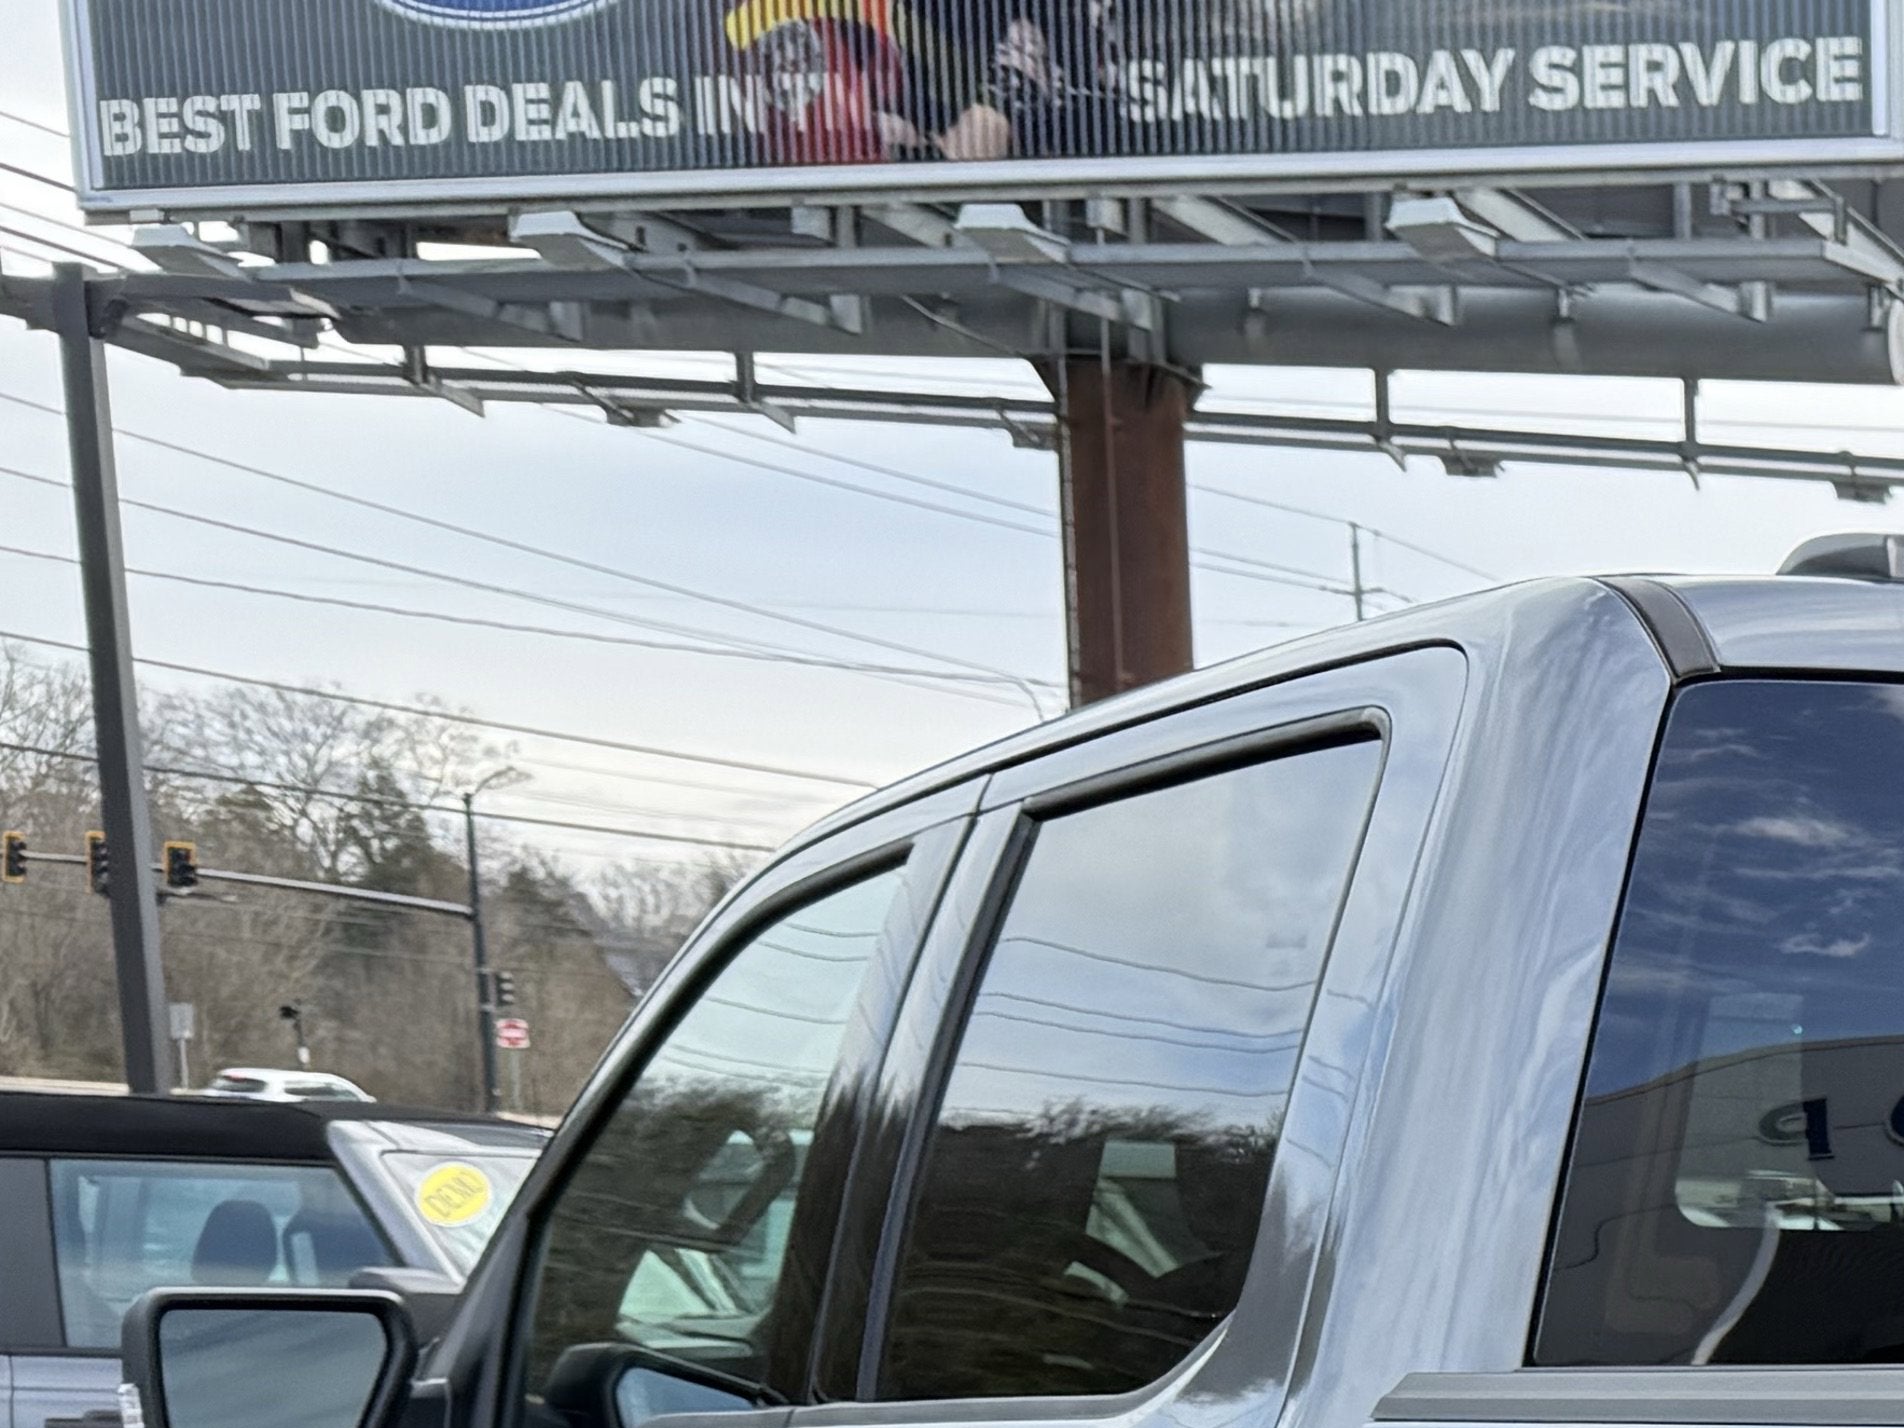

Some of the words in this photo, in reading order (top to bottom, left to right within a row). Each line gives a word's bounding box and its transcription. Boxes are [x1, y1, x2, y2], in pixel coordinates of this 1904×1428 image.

[99, 93, 261, 157] BEST
[272, 86, 452, 151] FORD
[464, 77, 680, 144] DEALS
[694, 74, 764, 136] IN
[1120, 48, 1516, 123] SATURDAY
[1528, 36, 1864, 112] SERVICE
